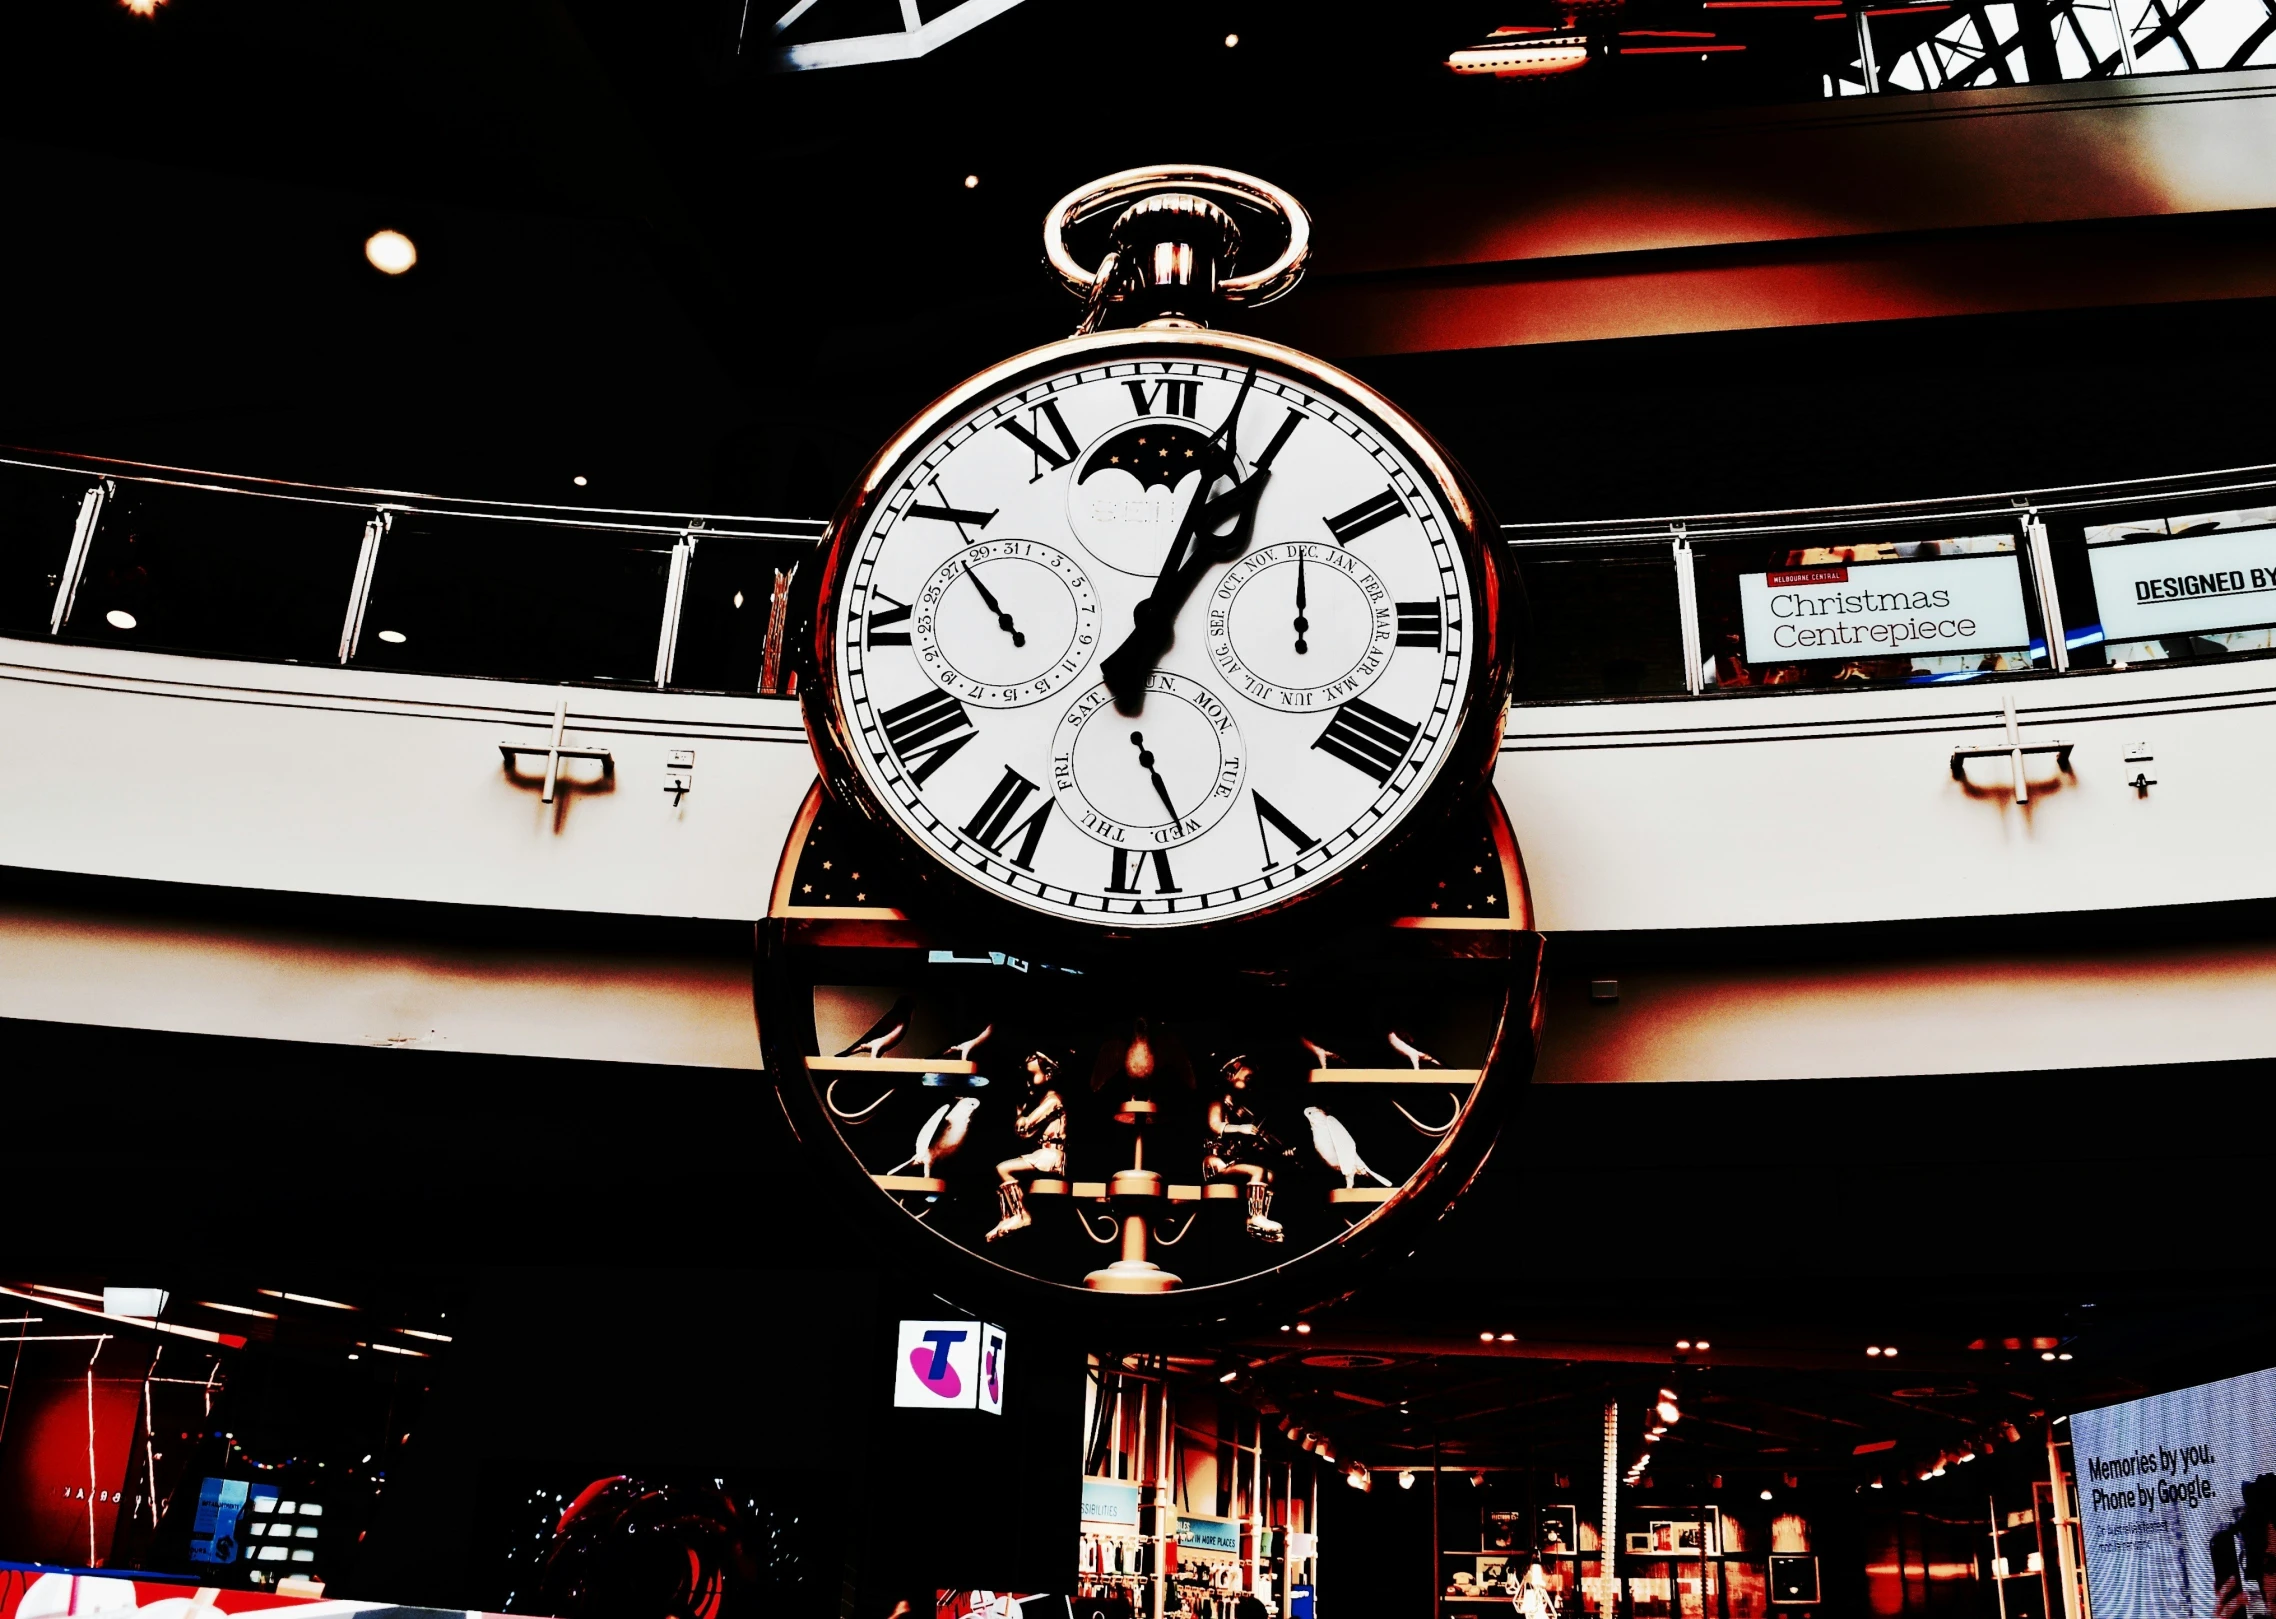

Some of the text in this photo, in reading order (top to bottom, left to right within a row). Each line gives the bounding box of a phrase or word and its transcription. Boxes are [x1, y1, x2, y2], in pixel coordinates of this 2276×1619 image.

[902, 473, 1000, 545] X
[1322, 483, 1412, 548] II
[969, 546, 991, 562] 29
[1003, 542, 1019, 554] 31
[1050, 554, 1065, 567] 3
[940, 561, 959, 580] 27
[1773, 572, 1840, 583] MELBOURNE CENTRAL
[1071, 576, 1086, 588] 5
[2135, 567, 2276, 601] DESIGNED BY
[923, 585, 941, 604] 25
[1770, 589, 1951, 618] Christmas
[1081, 604, 1096, 614] 7
[917, 615, 932, 633] 23
[1210, 545, 1390, 706] JAN. FEB. MAR. APR. MAY. JUN. JUL. AUG. SEP. OCT. NOV. DEC.
[1773, 617, 1976, 648] Centrepiece
[1078, 634, 1093, 645] 9
[922, 644, 939, 662] 21
[1061, 658, 1077, 673] 11
[940, 670, 958, 686] 19
[1034, 678, 1050, 694] 13
[967, 685, 985, 700] 17
[1002, 688, 1018, 702] 15
[1054, 675, 1239, 844] UN. MON. TUE. WED. THU. FRI. SAT.
[958, 763, 1056, 873] VII
[1251, 787, 1322, 872] V
[2088, 1444, 2215, 1482] Memories by you.
[2092, 1474, 2216, 1512] Phone by Google.
[1217, 1537, 1236, 1548] PLACES
